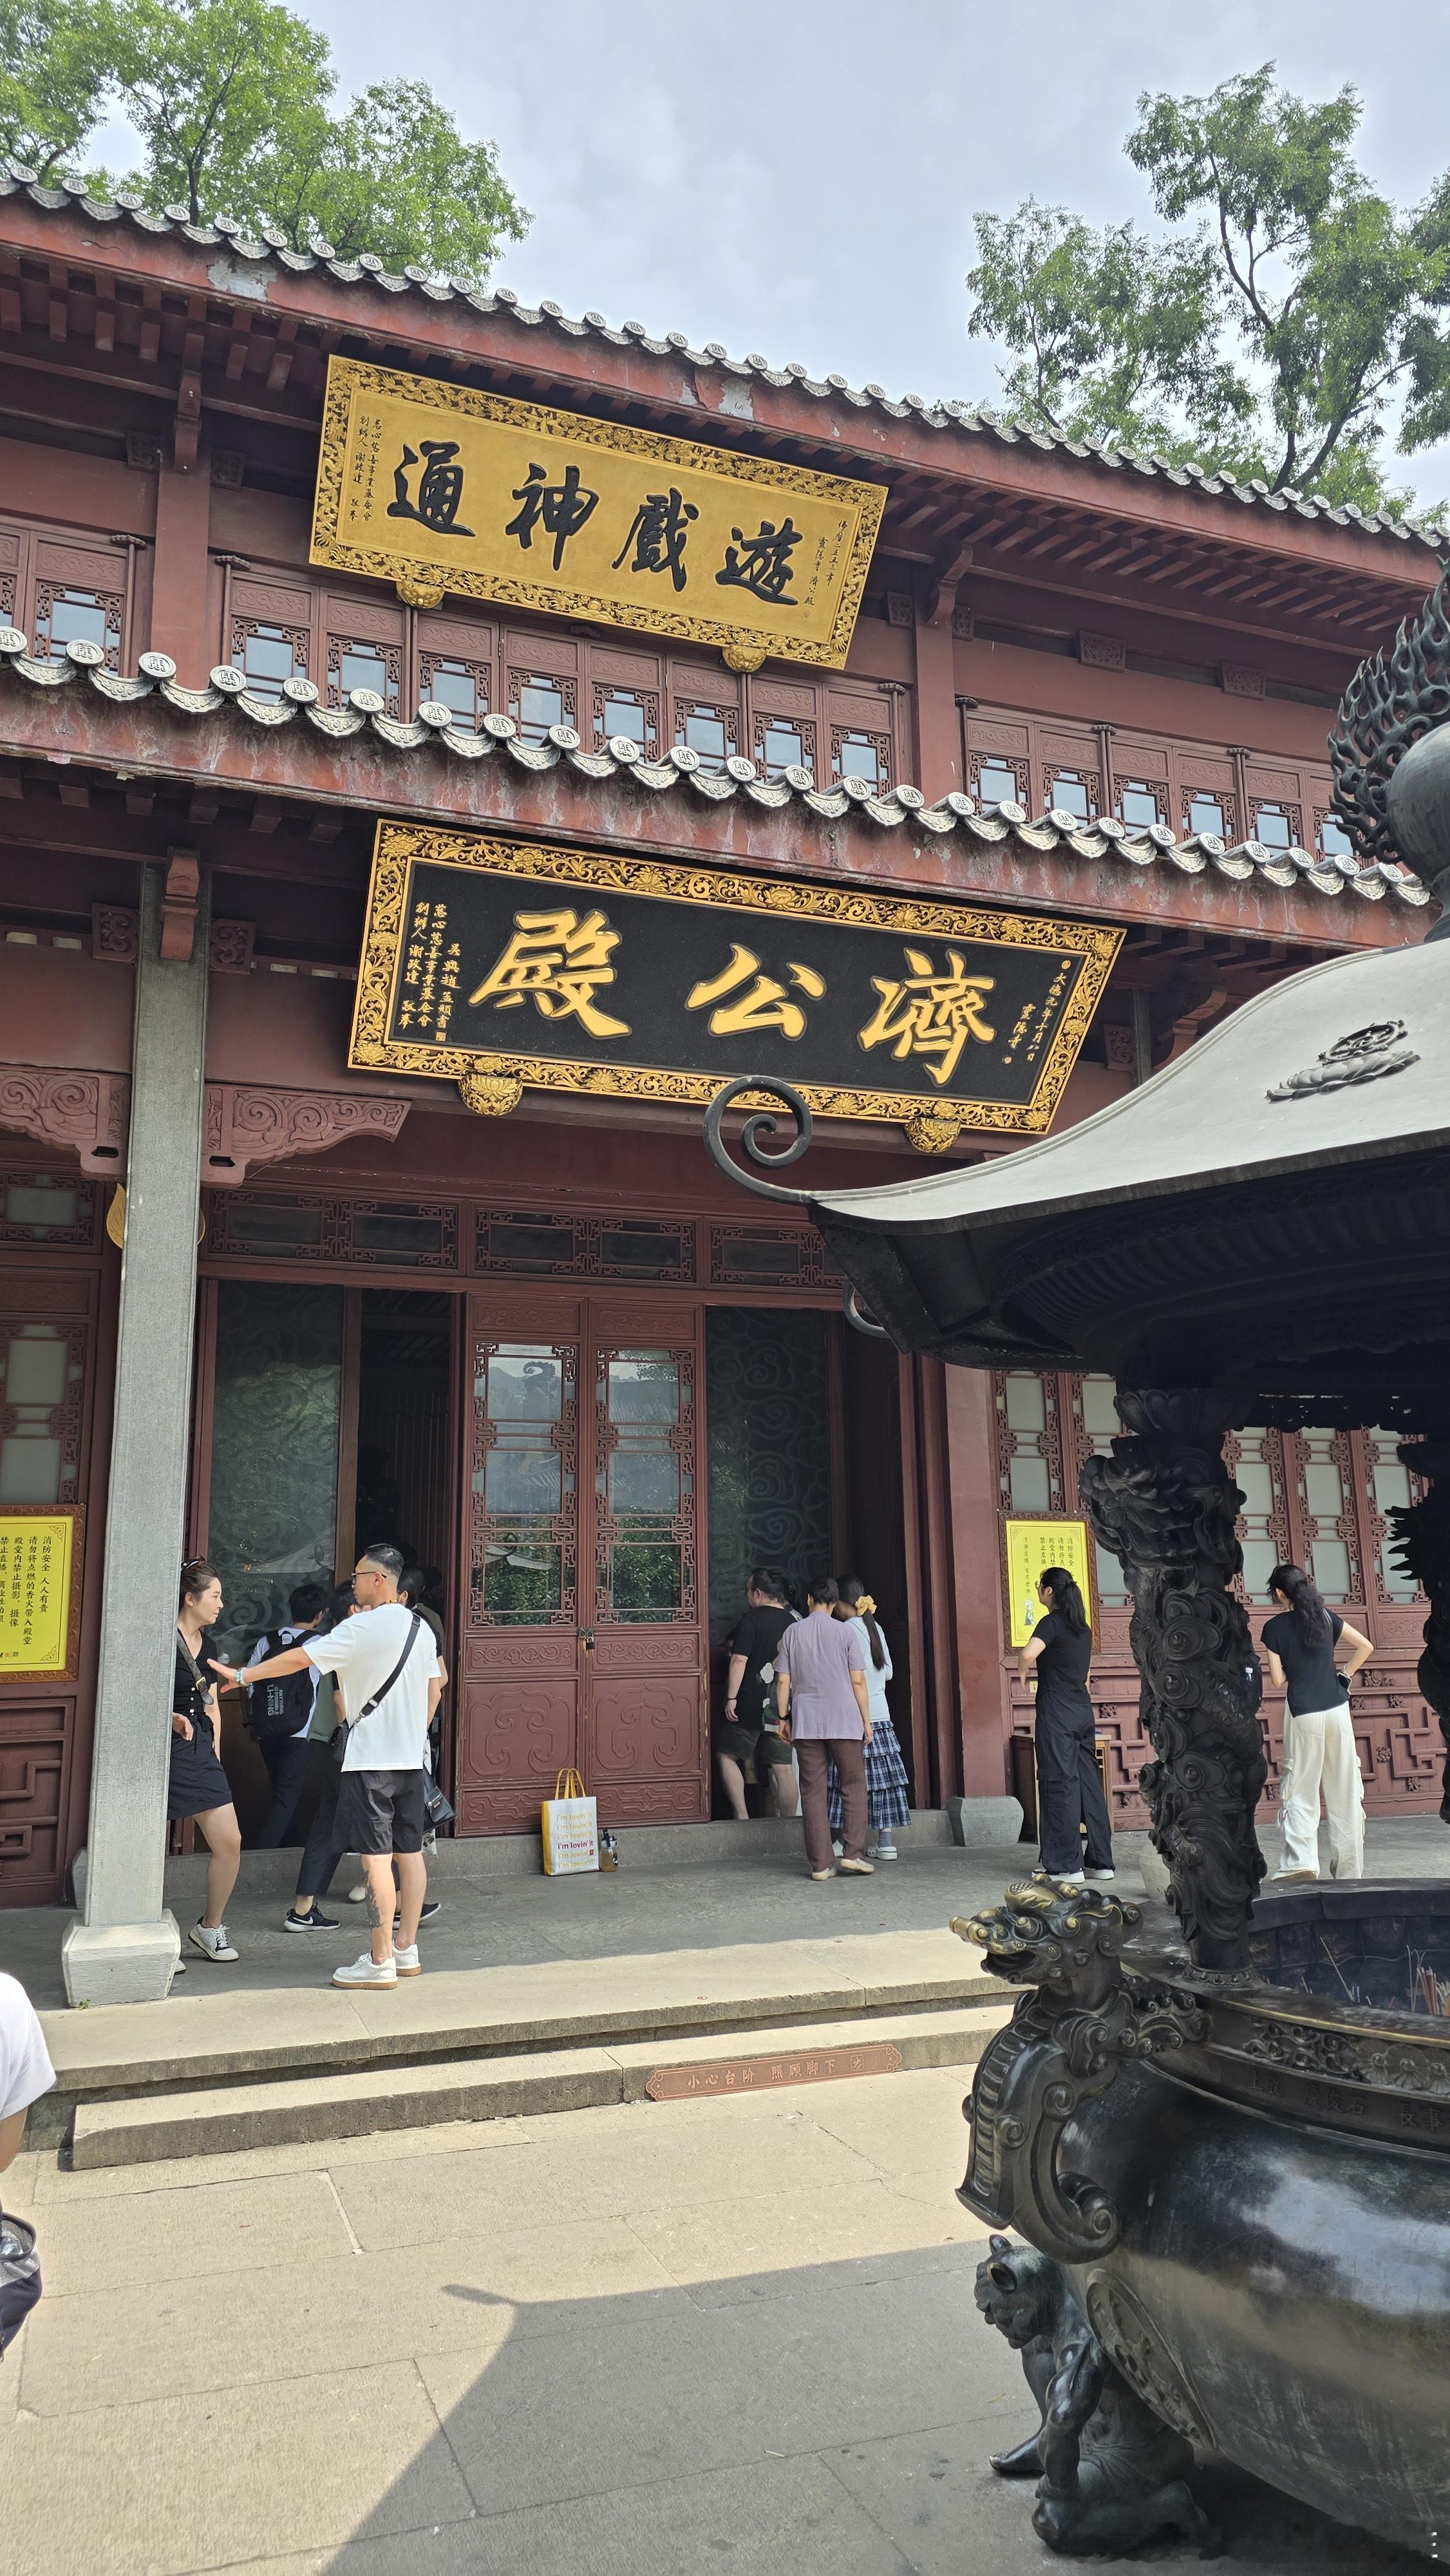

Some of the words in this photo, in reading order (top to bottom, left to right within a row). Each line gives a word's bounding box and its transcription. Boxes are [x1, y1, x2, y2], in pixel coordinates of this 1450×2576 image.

[469, 907, 997, 1086] 濟公殿
[41, 1536, 52, 1572] 消防安全
[23, 1536, 38, 1645] 请勿将点燃的香火带入殿堂
[39, 1577, 50, 1613] 人人有责
[570, 1821, 588, 1830] lovin'
[570, 1831, 588, 1839] lovin'
[570, 1840, 588, 1849] lovin'
[687, 2067, 756, 2089] 小心台阶
[771, 2058, 836, 2080] 照顾脚下
[1399, 2101, 1450, 2134] 事長
